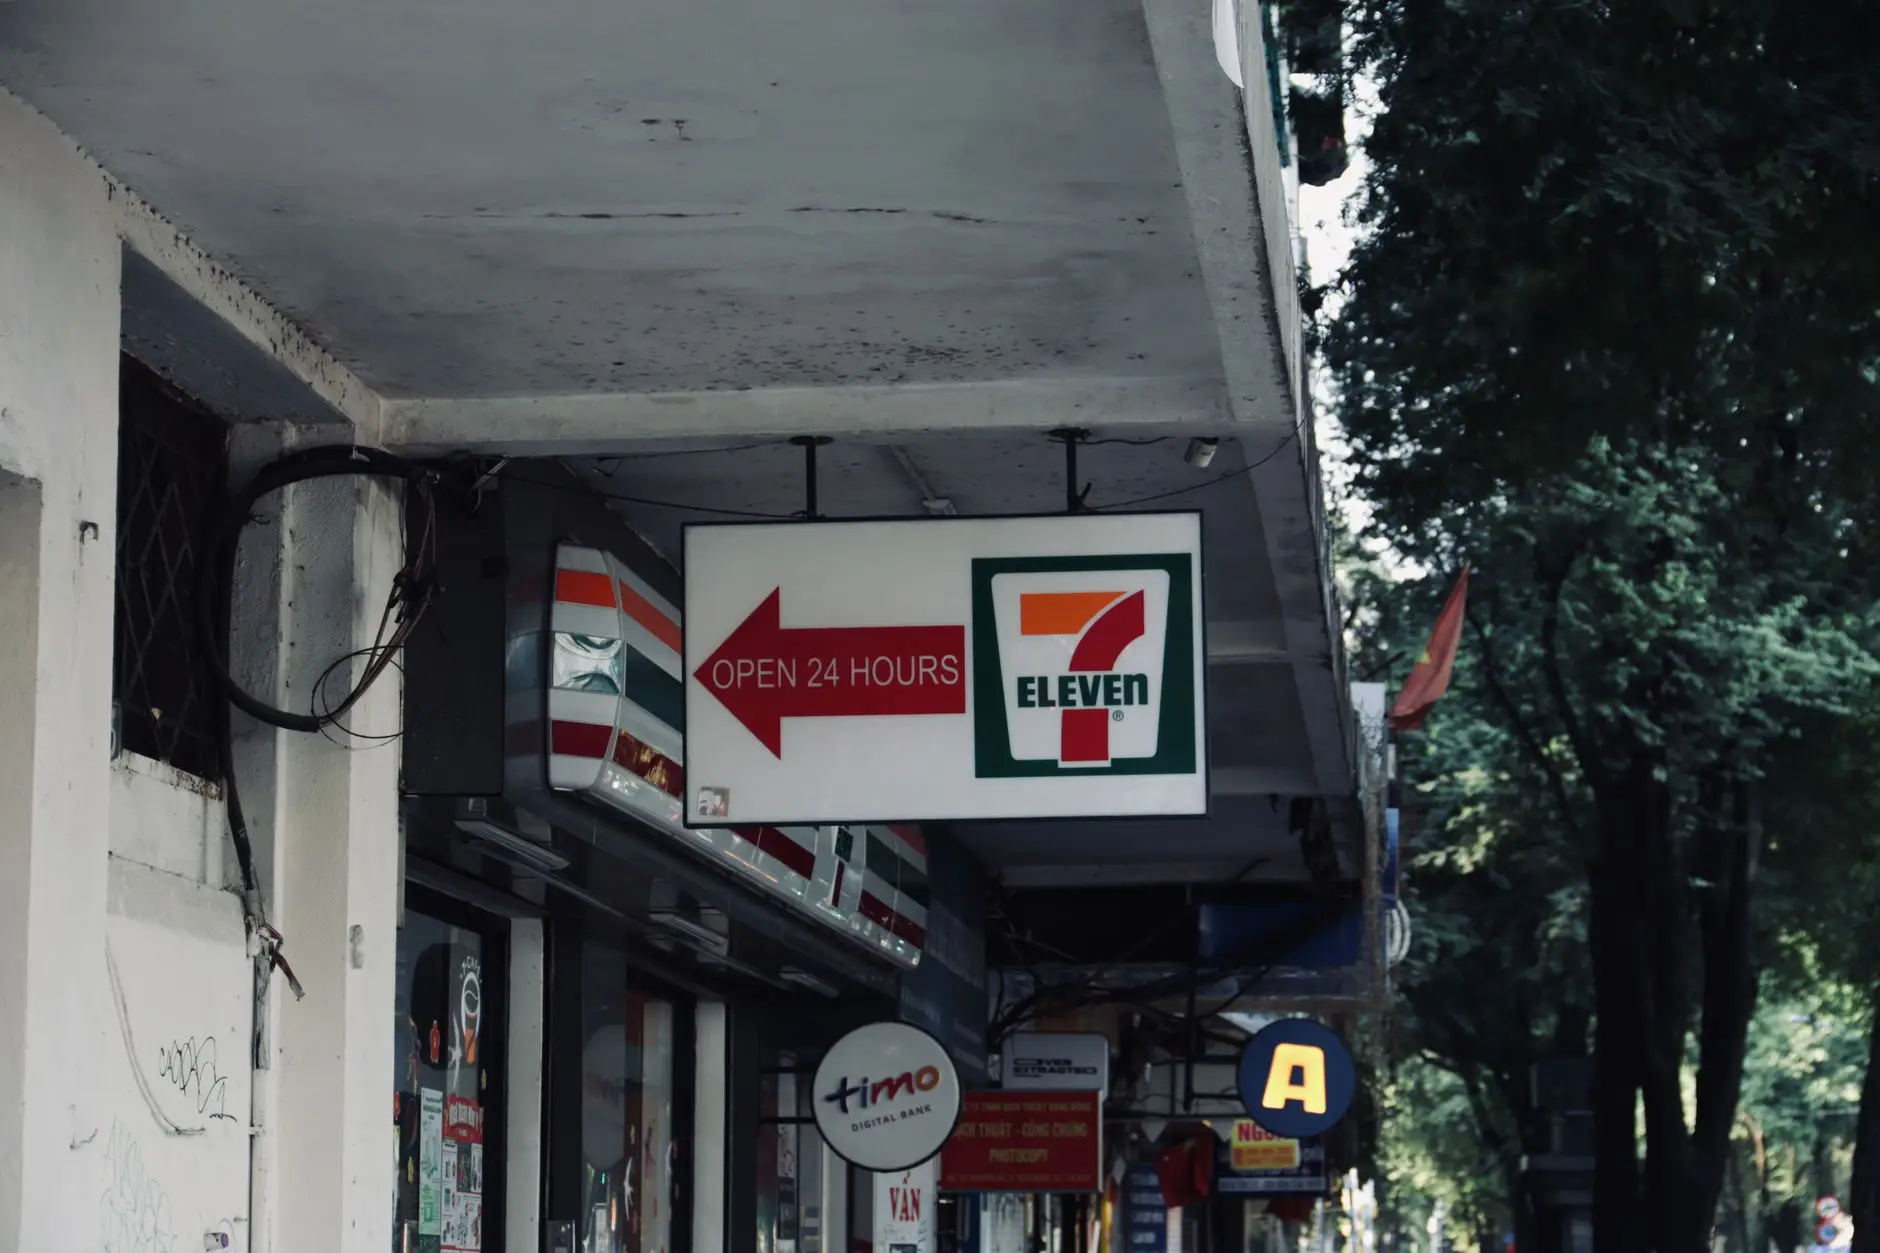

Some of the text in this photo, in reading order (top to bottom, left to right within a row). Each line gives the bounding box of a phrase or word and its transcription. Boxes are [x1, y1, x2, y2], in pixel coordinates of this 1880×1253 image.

[712, 655, 960, 690] OPEN 24 HOURS
[824, 1065, 940, 1114] timo
[1262, 1043, 1327, 1114] A
[851, 1104, 932, 1133] DIGITAL BANK
